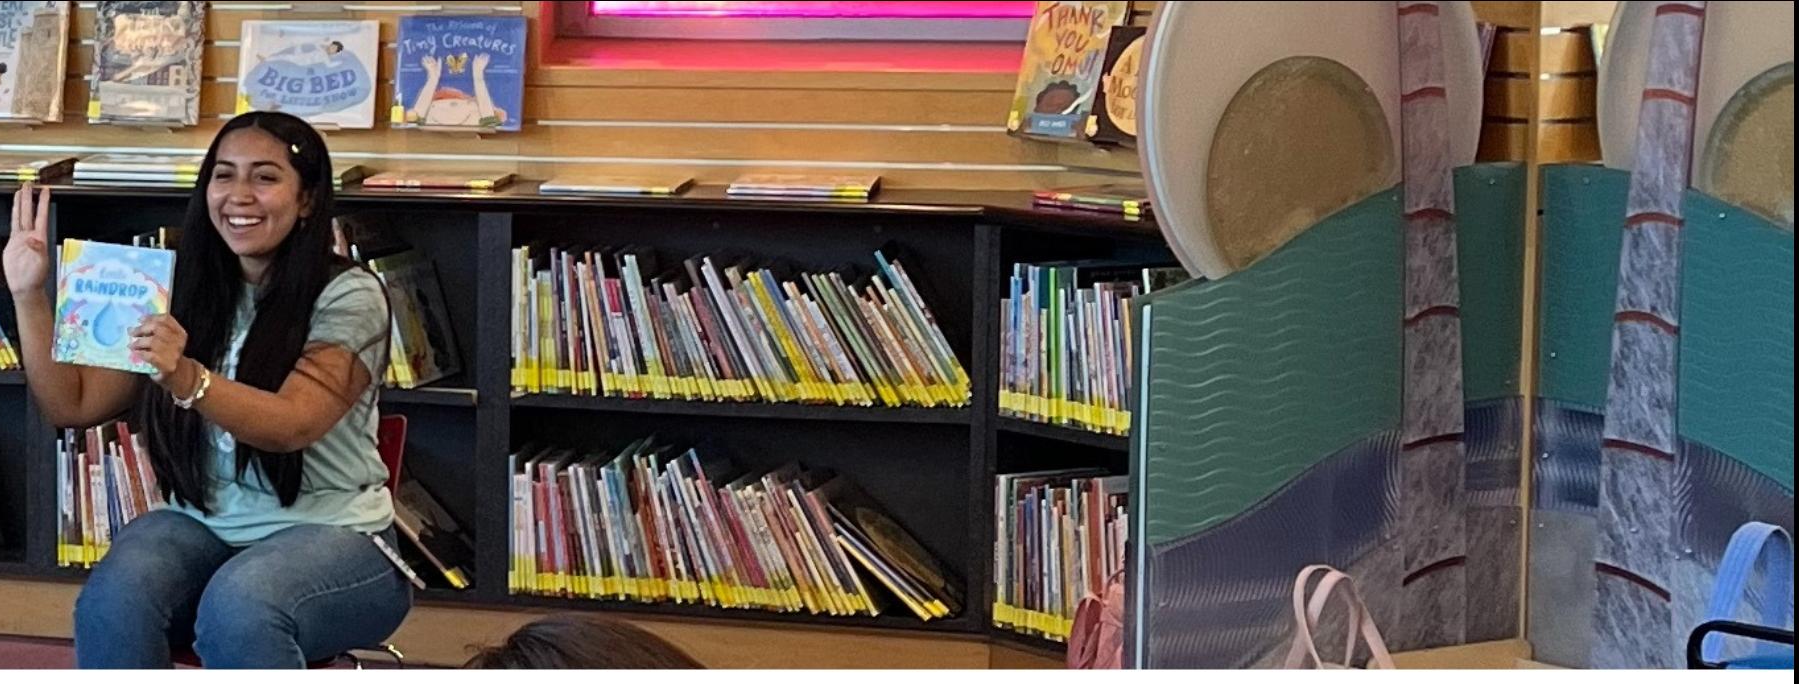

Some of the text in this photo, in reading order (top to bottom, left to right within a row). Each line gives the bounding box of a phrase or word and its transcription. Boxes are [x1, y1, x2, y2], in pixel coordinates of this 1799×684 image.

[1043, 2, 1105, 37] THANK
[403, 36, 437, 55] Tiny
[258, 66, 305, 94] BIG
[310, 69, 357, 94] BED
